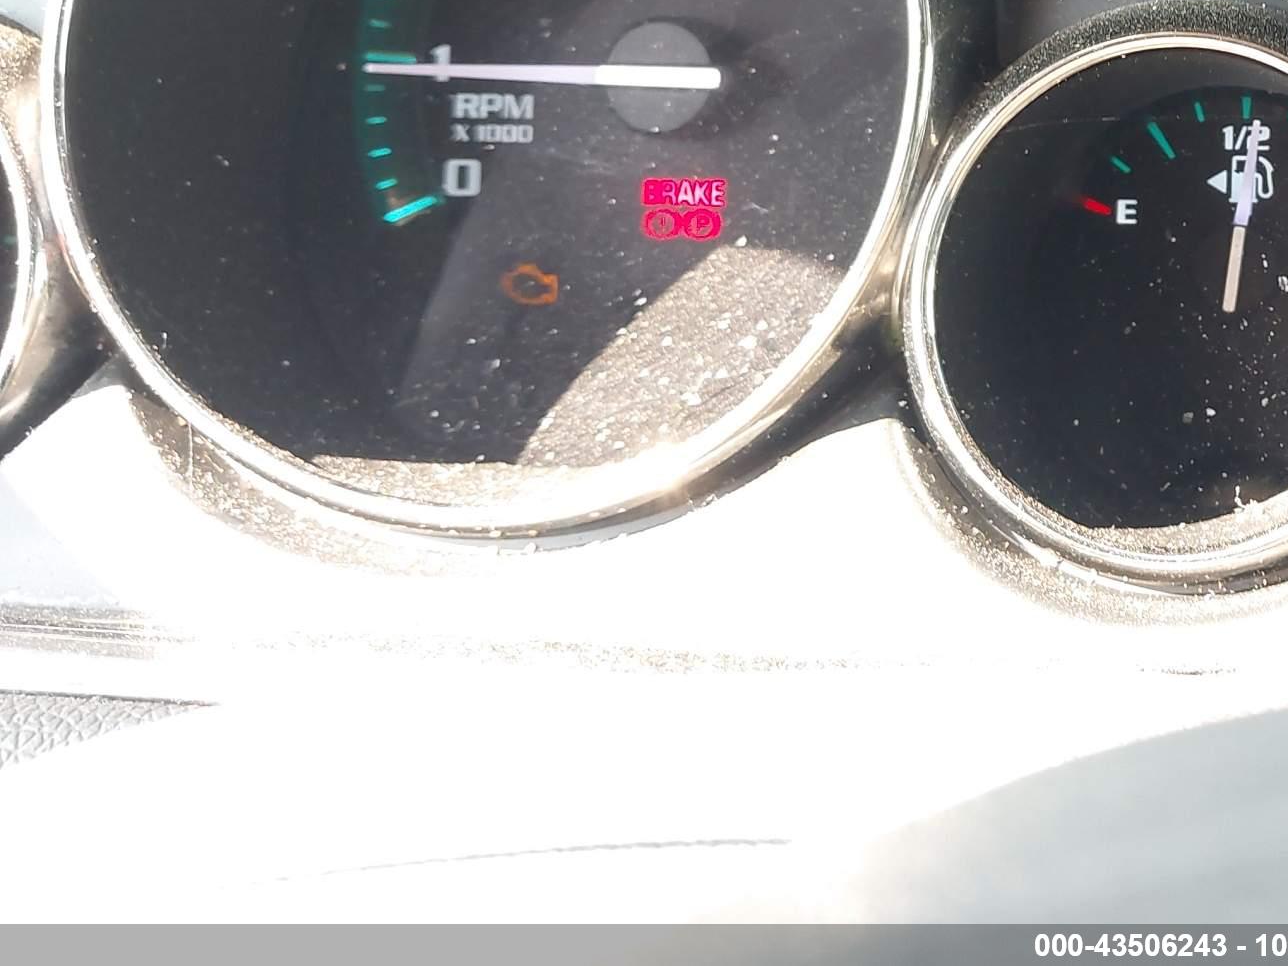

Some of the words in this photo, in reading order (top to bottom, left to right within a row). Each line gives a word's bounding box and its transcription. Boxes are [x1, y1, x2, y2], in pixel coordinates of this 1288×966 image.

[430, 44, 452, 82] 1
[452, 93, 534, 120] RPM
[474, 124, 534, 143] 1000
[441, 158, 482, 197] 0
[642, 178, 726, 207] BRAKE
[1115, 198, 1138, 225] E
